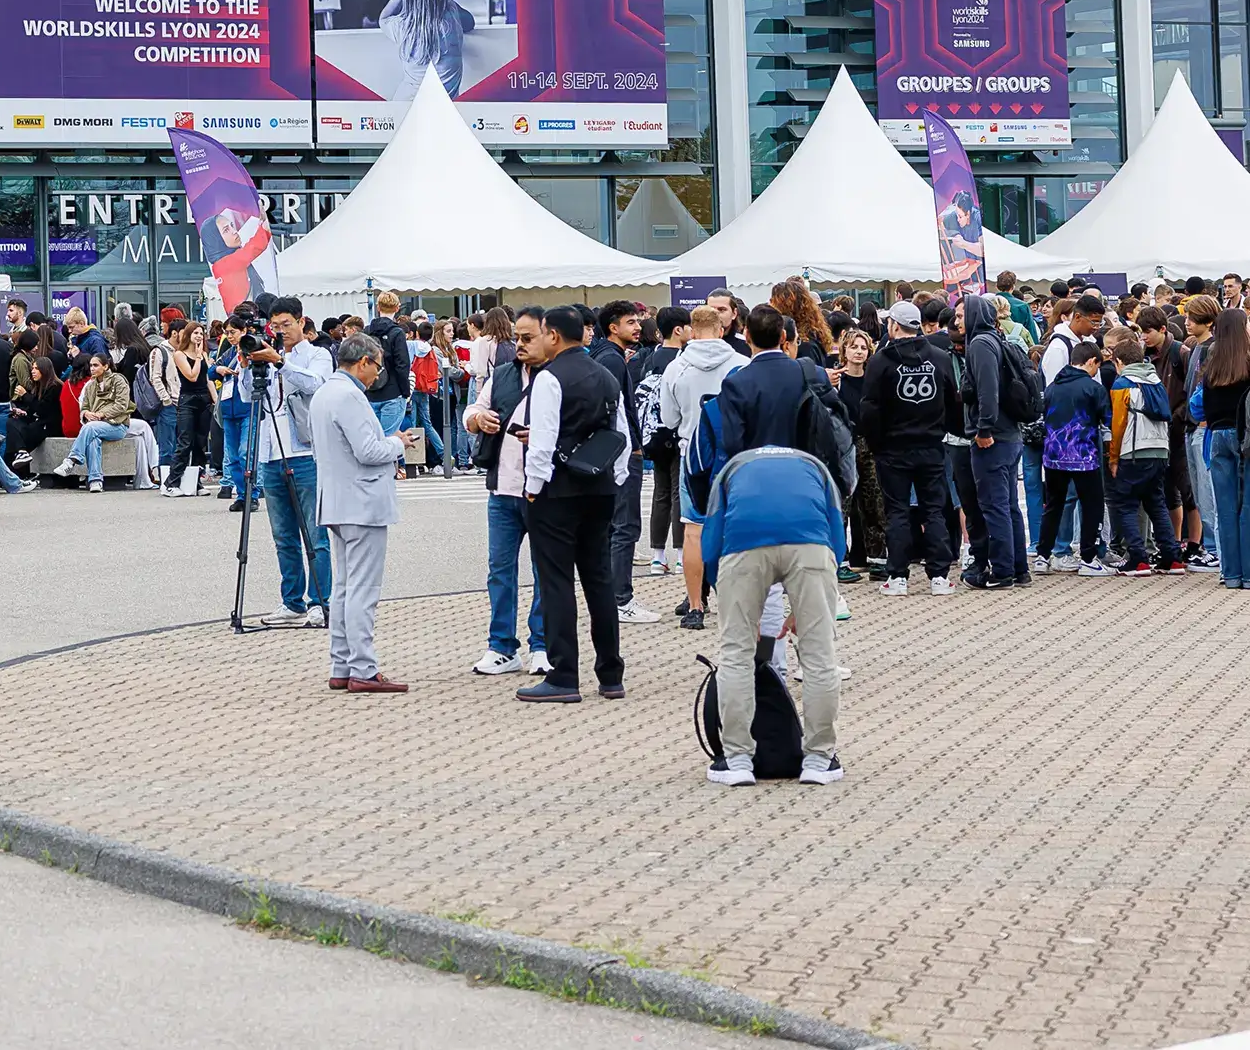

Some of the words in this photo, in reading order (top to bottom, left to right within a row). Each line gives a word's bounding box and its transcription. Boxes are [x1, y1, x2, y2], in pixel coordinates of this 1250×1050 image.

[952, 7, 989, 15] worldskills
[952, 15, 985, 25] Lyon2024
[23, 19, 155, 38] WORLDSKILLS
[161, 22, 211, 38] LYON
[216, 23, 260, 39] 2024
[953, 39, 990, 48] SAMSUNG
[134, 46, 260, 64] COMPETITION
[507, 72, 558, 89] 11-14
[562, 72, 609, 90] SEPT.
[614, 73, 658, 89] 2024
[897, 76, 972, 92] GROUPES
[975, 77, 982, 92] /
[985, 76, 1050, 92] GROUPS
[54, 118, 81, 127] DMG
[83, 118, 113, 127] MORI
[121, 118, 166, 128] FESTO
[203, 117, 261, 129] SAMSUNG
[477, 119, 484, 130] 3
[902, 365, 932, 373] ROUTE
[903, 376, 932, 397] 66
